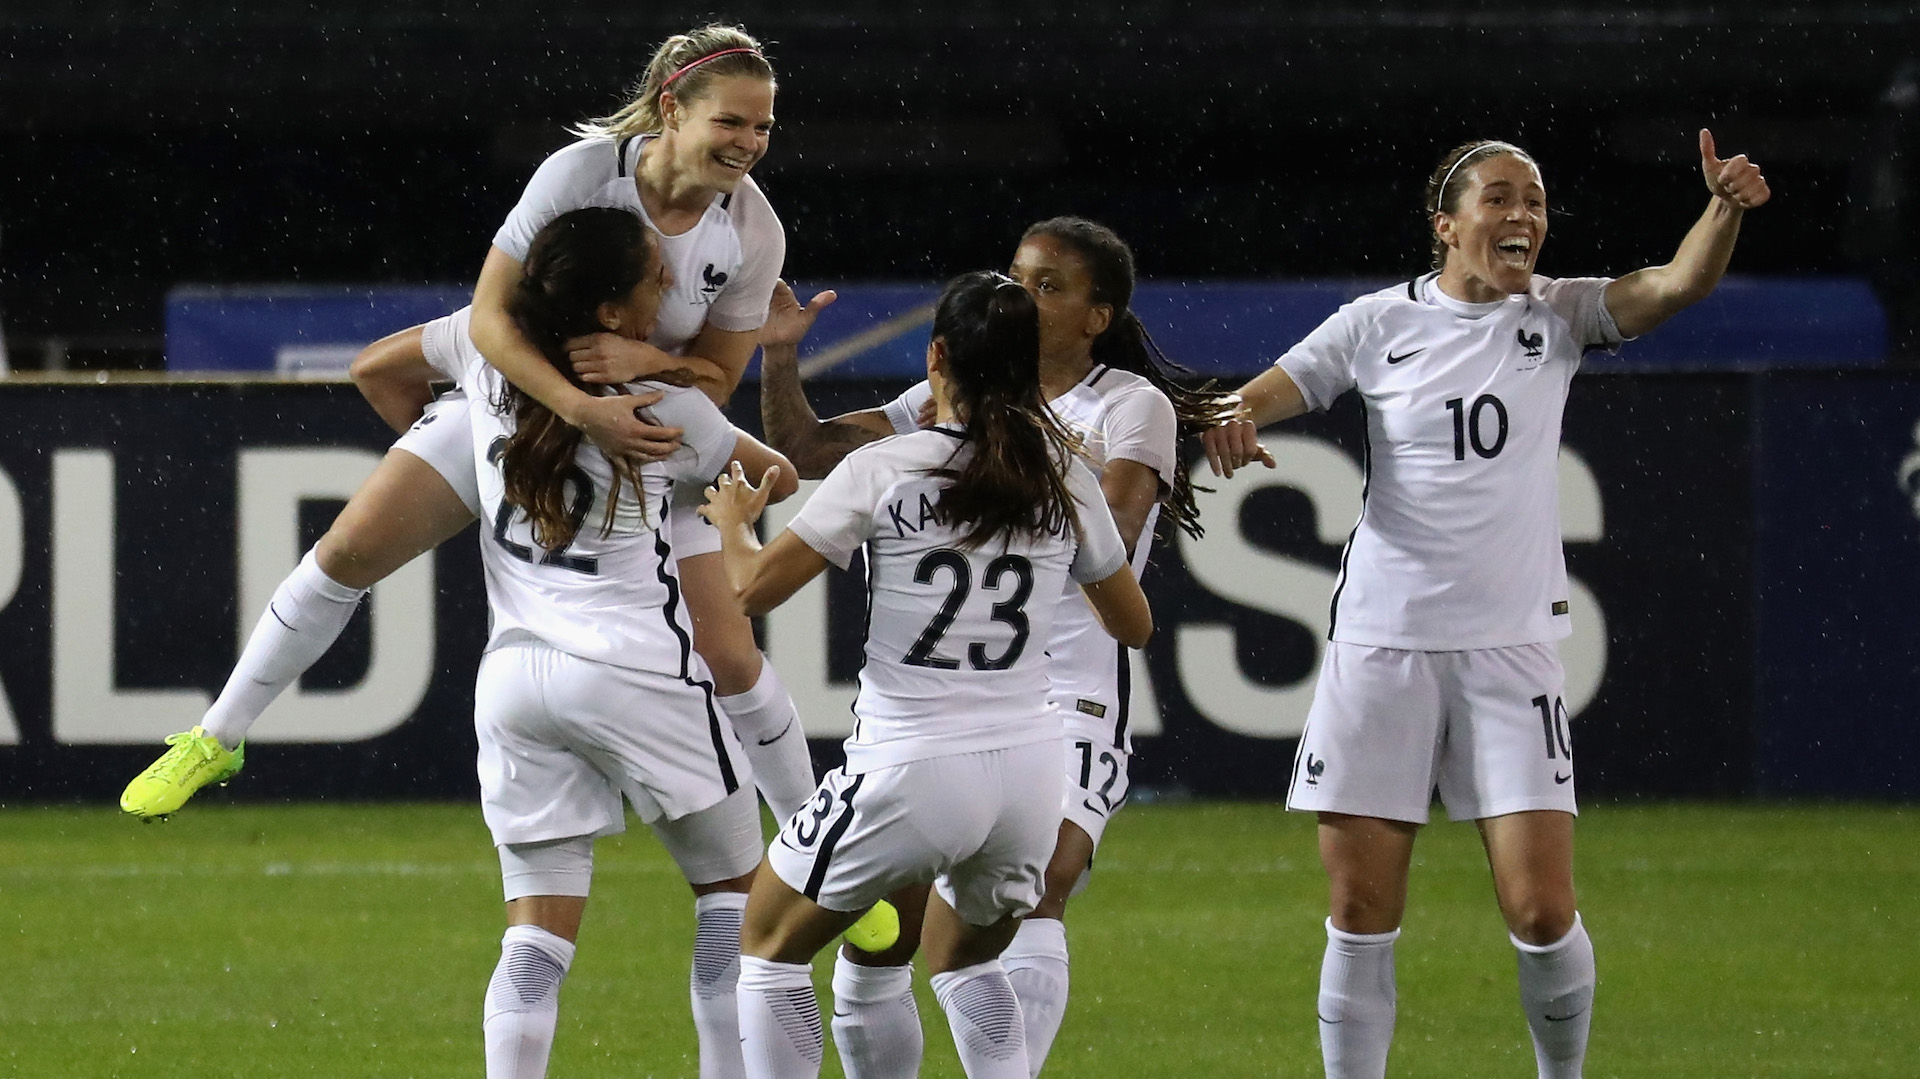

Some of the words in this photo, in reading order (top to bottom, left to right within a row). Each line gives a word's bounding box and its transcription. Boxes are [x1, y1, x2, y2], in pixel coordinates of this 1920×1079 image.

[1446, 394, 1508, 461] 10
[0, 448, 436, 744] LD
[902, 549, 1034, 670] 23
[1531, 694, 1571, 760] 10
[1075, 742, 1118, 812] 12
[792, 788, 833, 847] 3
